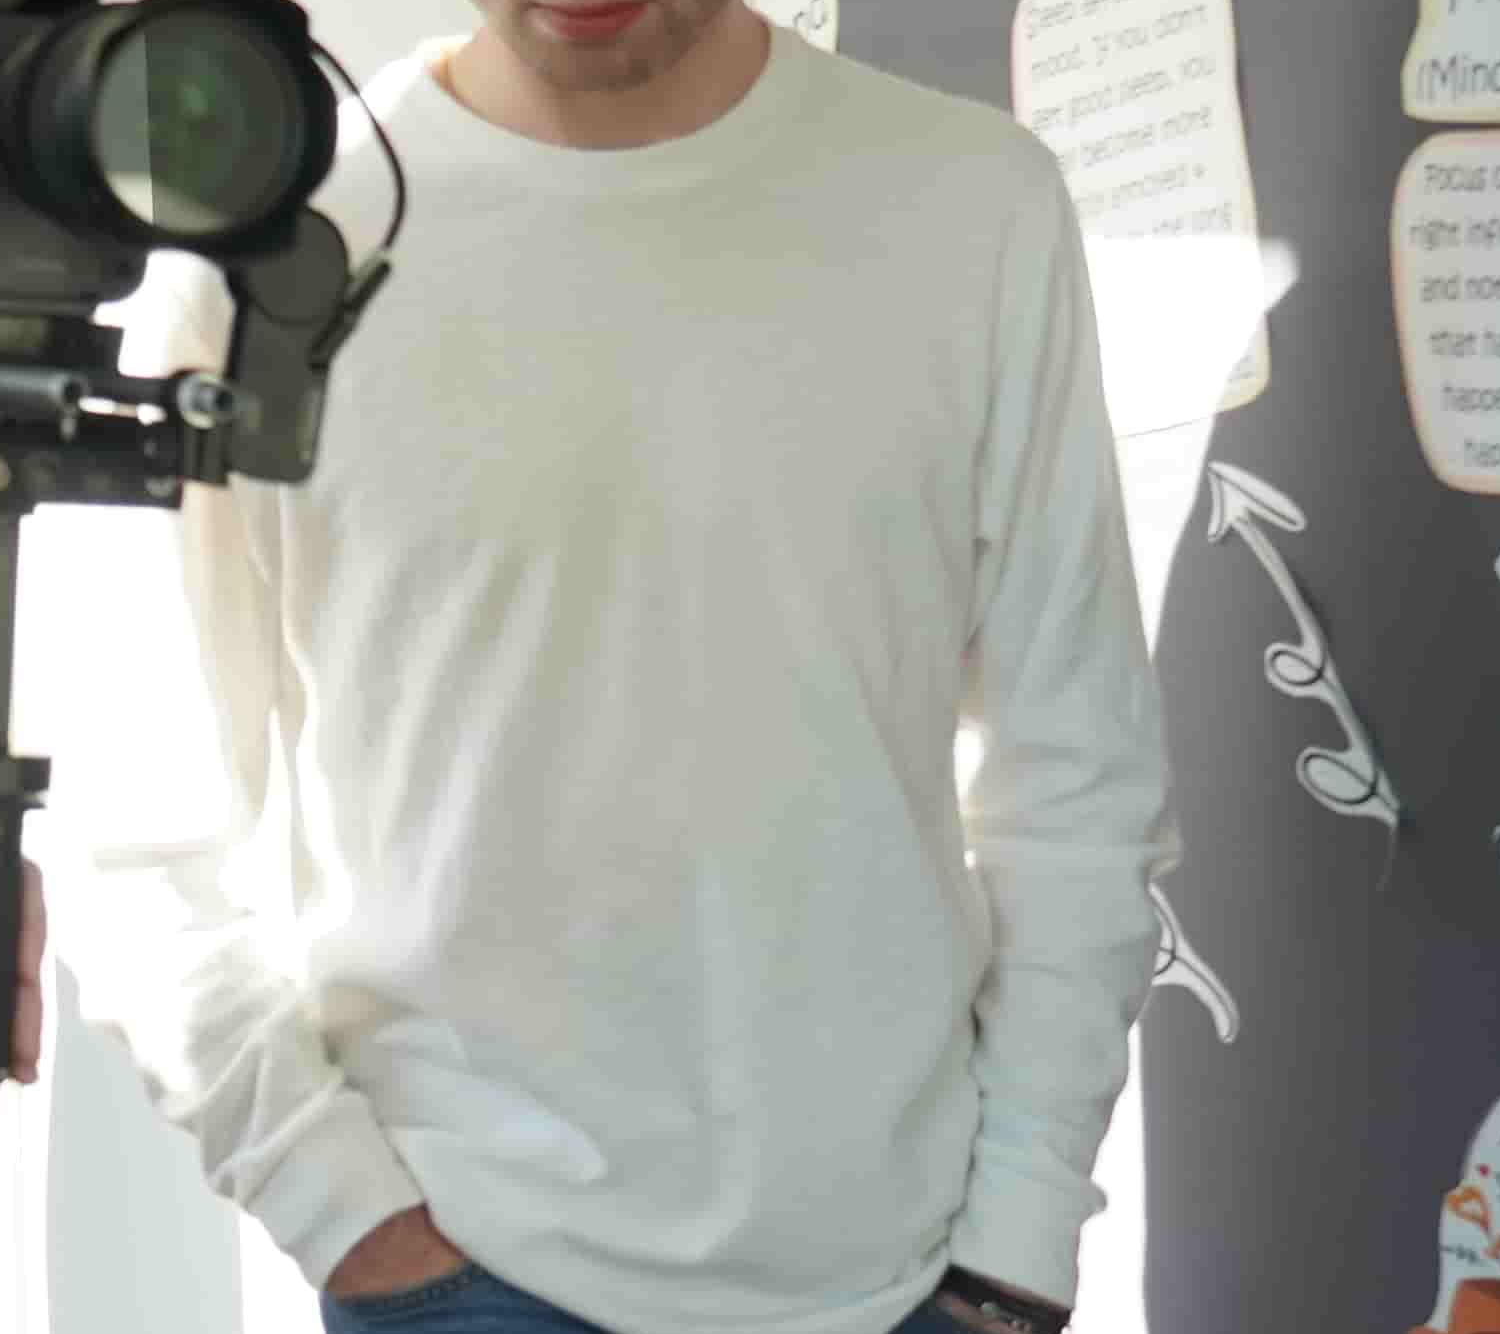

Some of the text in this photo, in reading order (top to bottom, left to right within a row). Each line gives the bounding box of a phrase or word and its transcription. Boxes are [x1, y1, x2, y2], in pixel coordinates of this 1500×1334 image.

[1408, 215, 1461, 251] right
[1420, 271, 1461, 303] and
[1428, 330, 1477, 359] that
